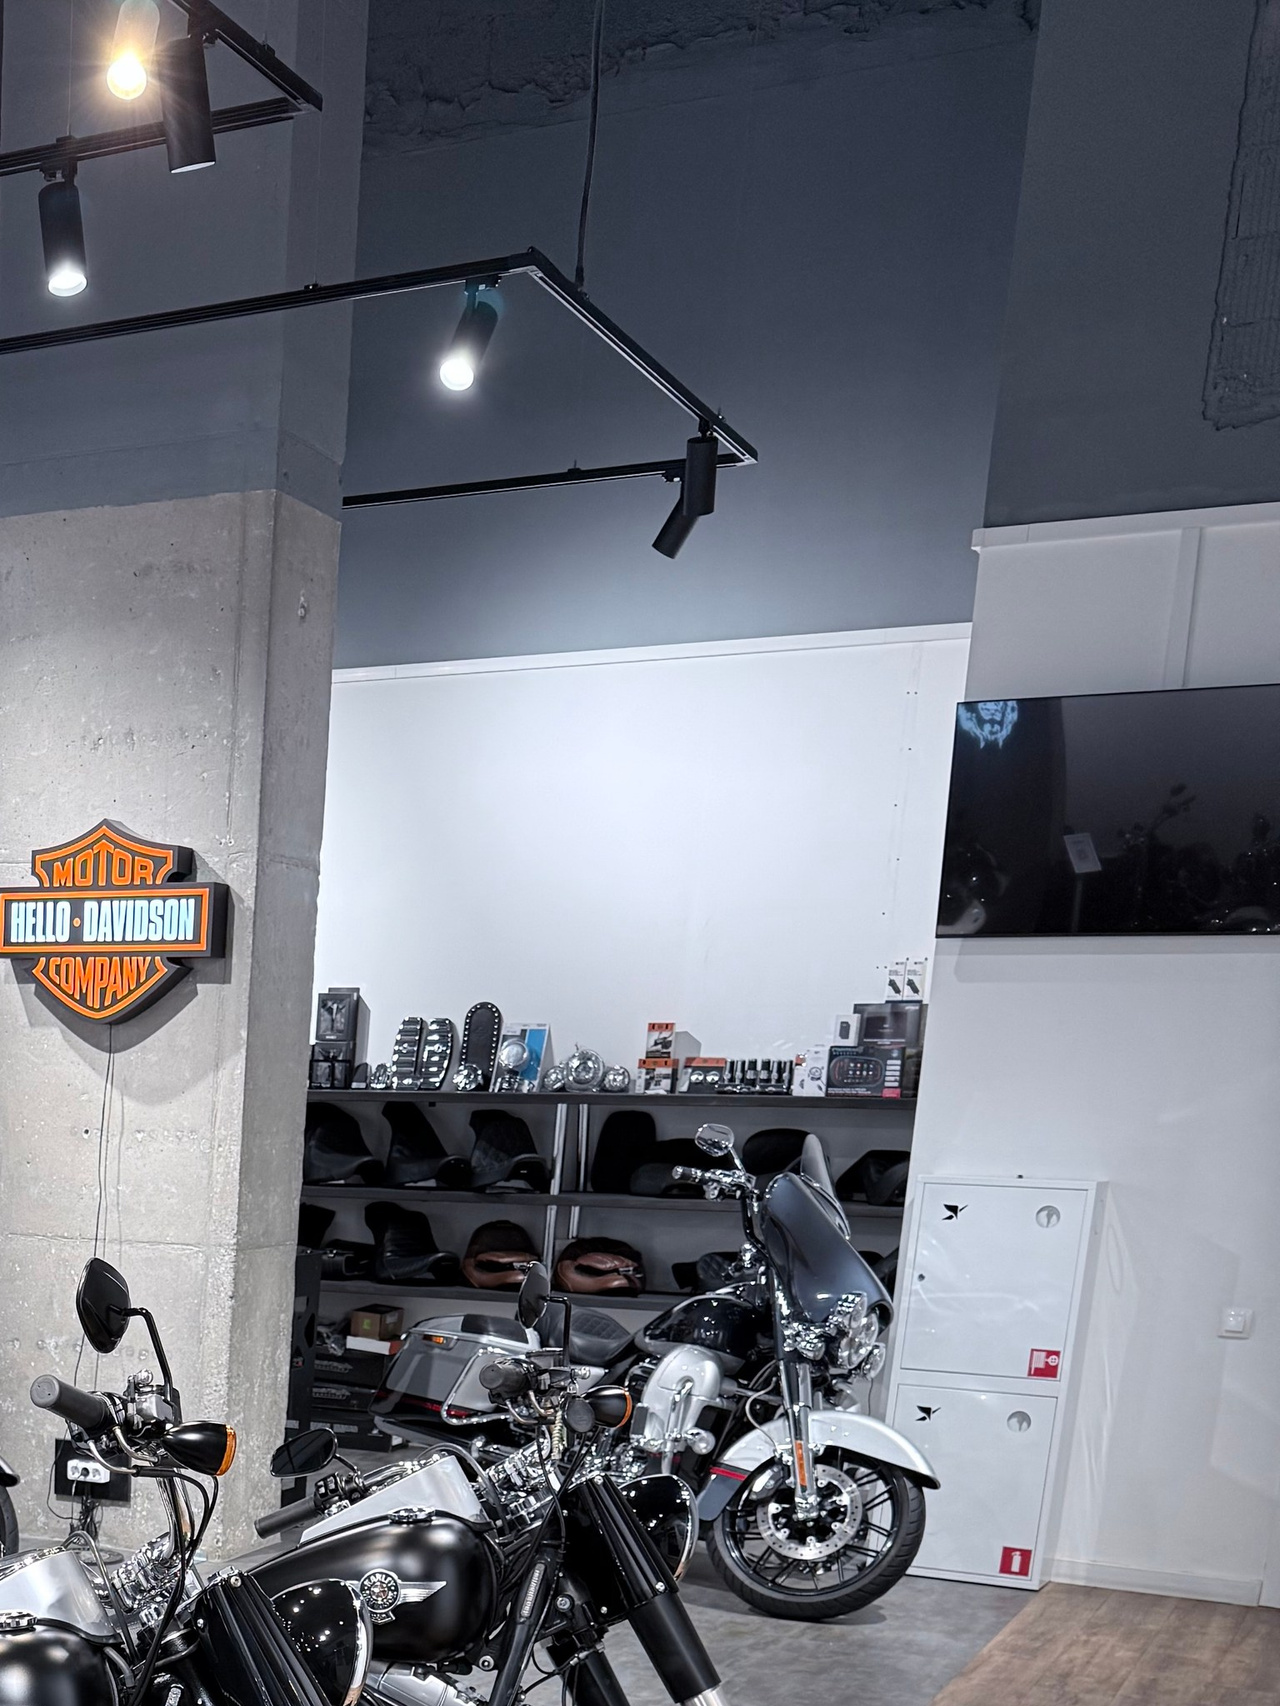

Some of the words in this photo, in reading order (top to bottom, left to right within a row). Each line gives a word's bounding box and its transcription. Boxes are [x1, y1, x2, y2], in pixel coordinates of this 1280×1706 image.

[53, 839, 154, 886] MOTOR
[10, 901, 71, 943] HELLO
[82, 898, 195, 942] DAVIDSON
[48, 956, 152, 1009] COMPANY
